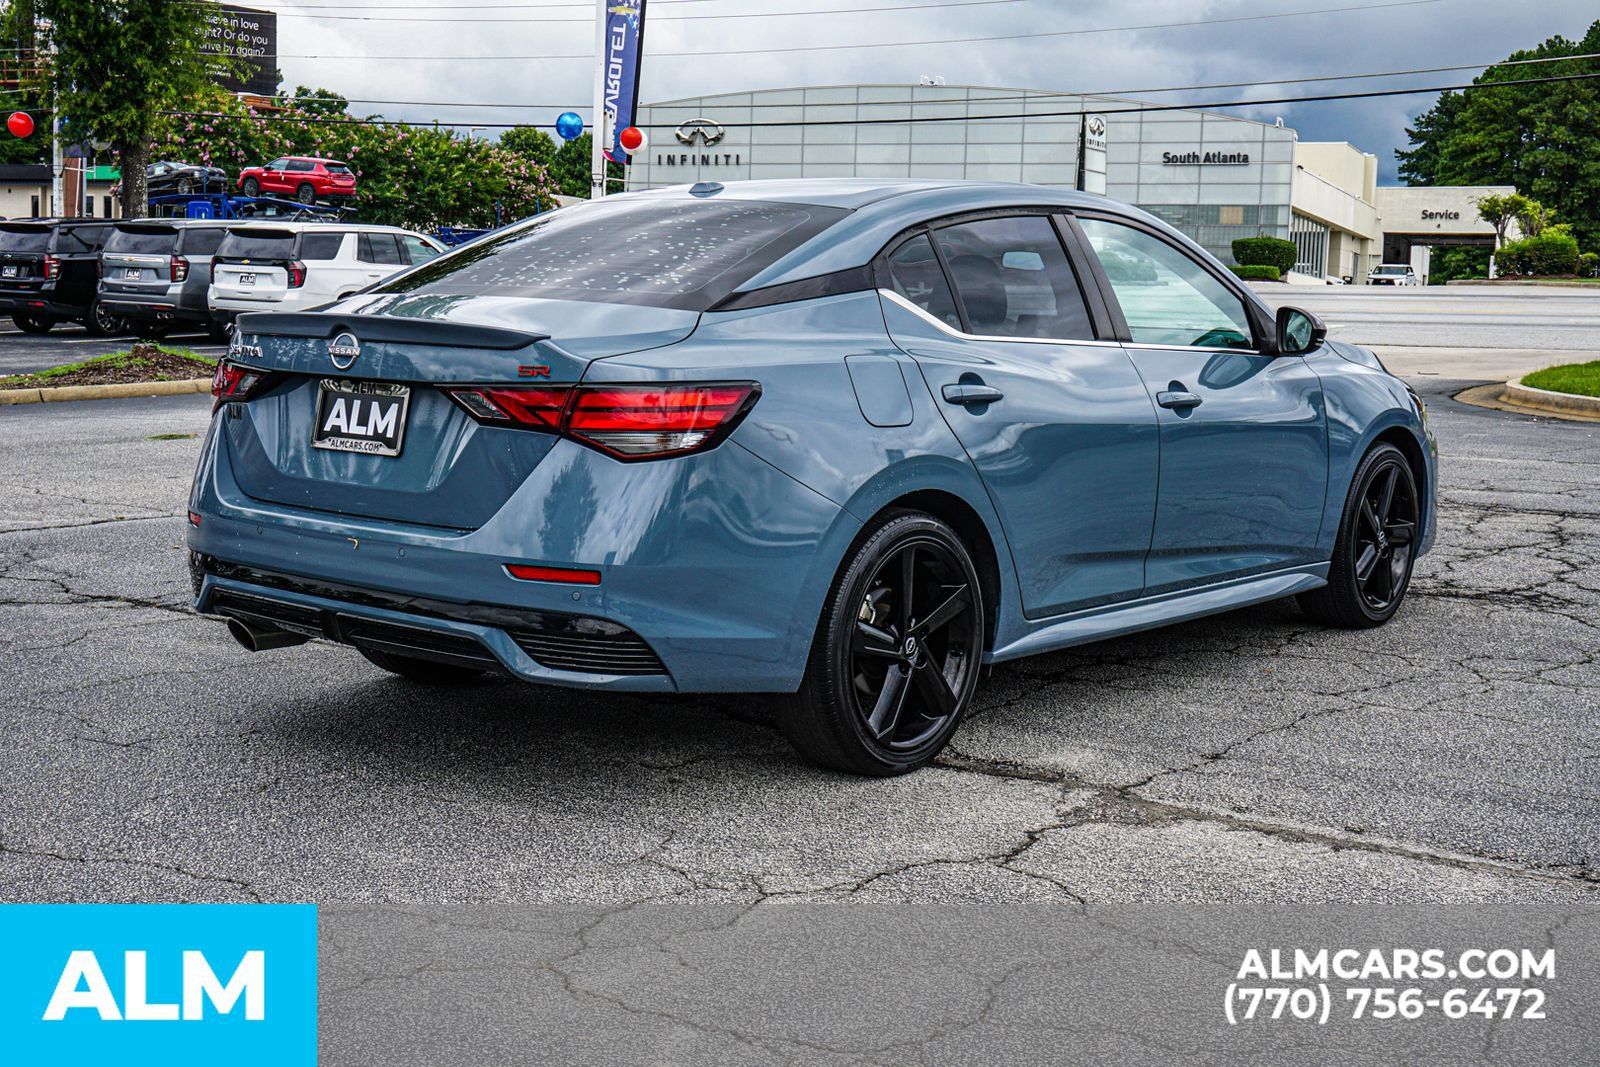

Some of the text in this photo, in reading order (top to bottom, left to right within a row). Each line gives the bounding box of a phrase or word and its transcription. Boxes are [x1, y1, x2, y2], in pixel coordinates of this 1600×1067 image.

[203, 15, 259, 30] elieve in love
[223, 29, 236, 40] Or
[237, 31, 250, 42] do
[251, 35, 268, 46] you
[223, 42, 235, 55] by
[236, 46, 266, 57] again?
[658, 154, 740, 166] INFINITI
[1162, 151, 1249, 165] South Atlanta
[1421, 209, 1460, 220] Service
[241, 275, 254, 283] ALM
[328, 345, 360, 356] NISSAN
[517, 364, 551, 378] SR
[352, 382, 377, 395] ALM
[323, 398, 399, 438] ALM
[330, 438, 380, 452] ALMCARS.COM
